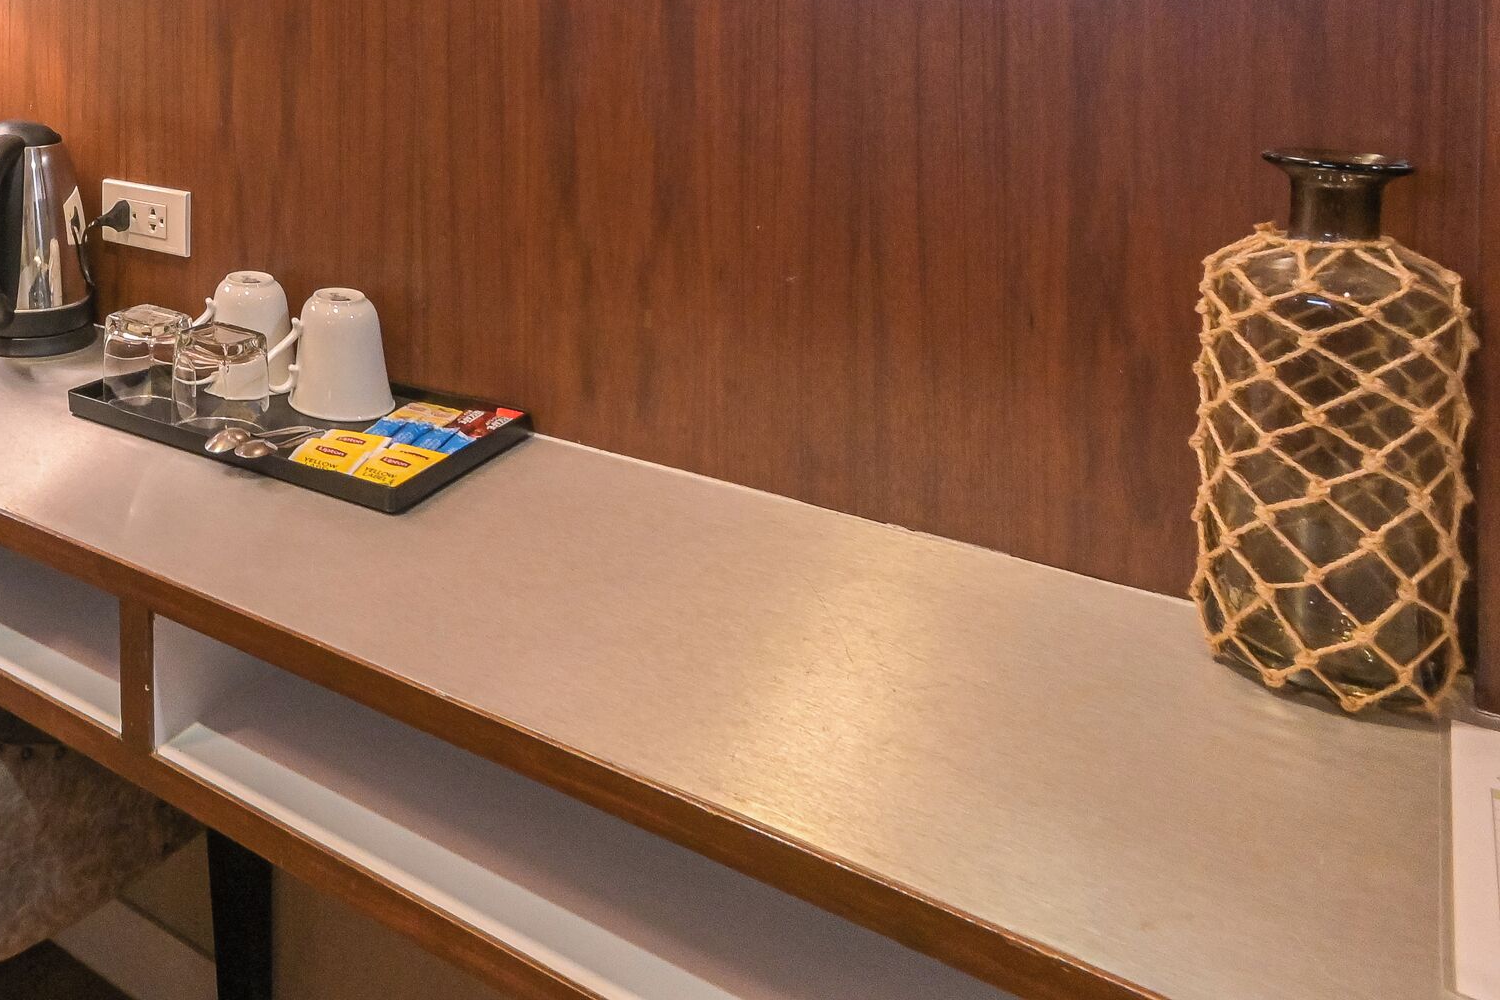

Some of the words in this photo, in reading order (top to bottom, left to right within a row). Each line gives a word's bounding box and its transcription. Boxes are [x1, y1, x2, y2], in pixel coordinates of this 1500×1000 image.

[319, 446, 345, 457] Lipton
[304, 456, 338, 469] YELLOW
[382, 456, 408, 467] Lipton
[363, 473, 387, 482] LABEL
[365, 467, 397, 478] YELLOW
